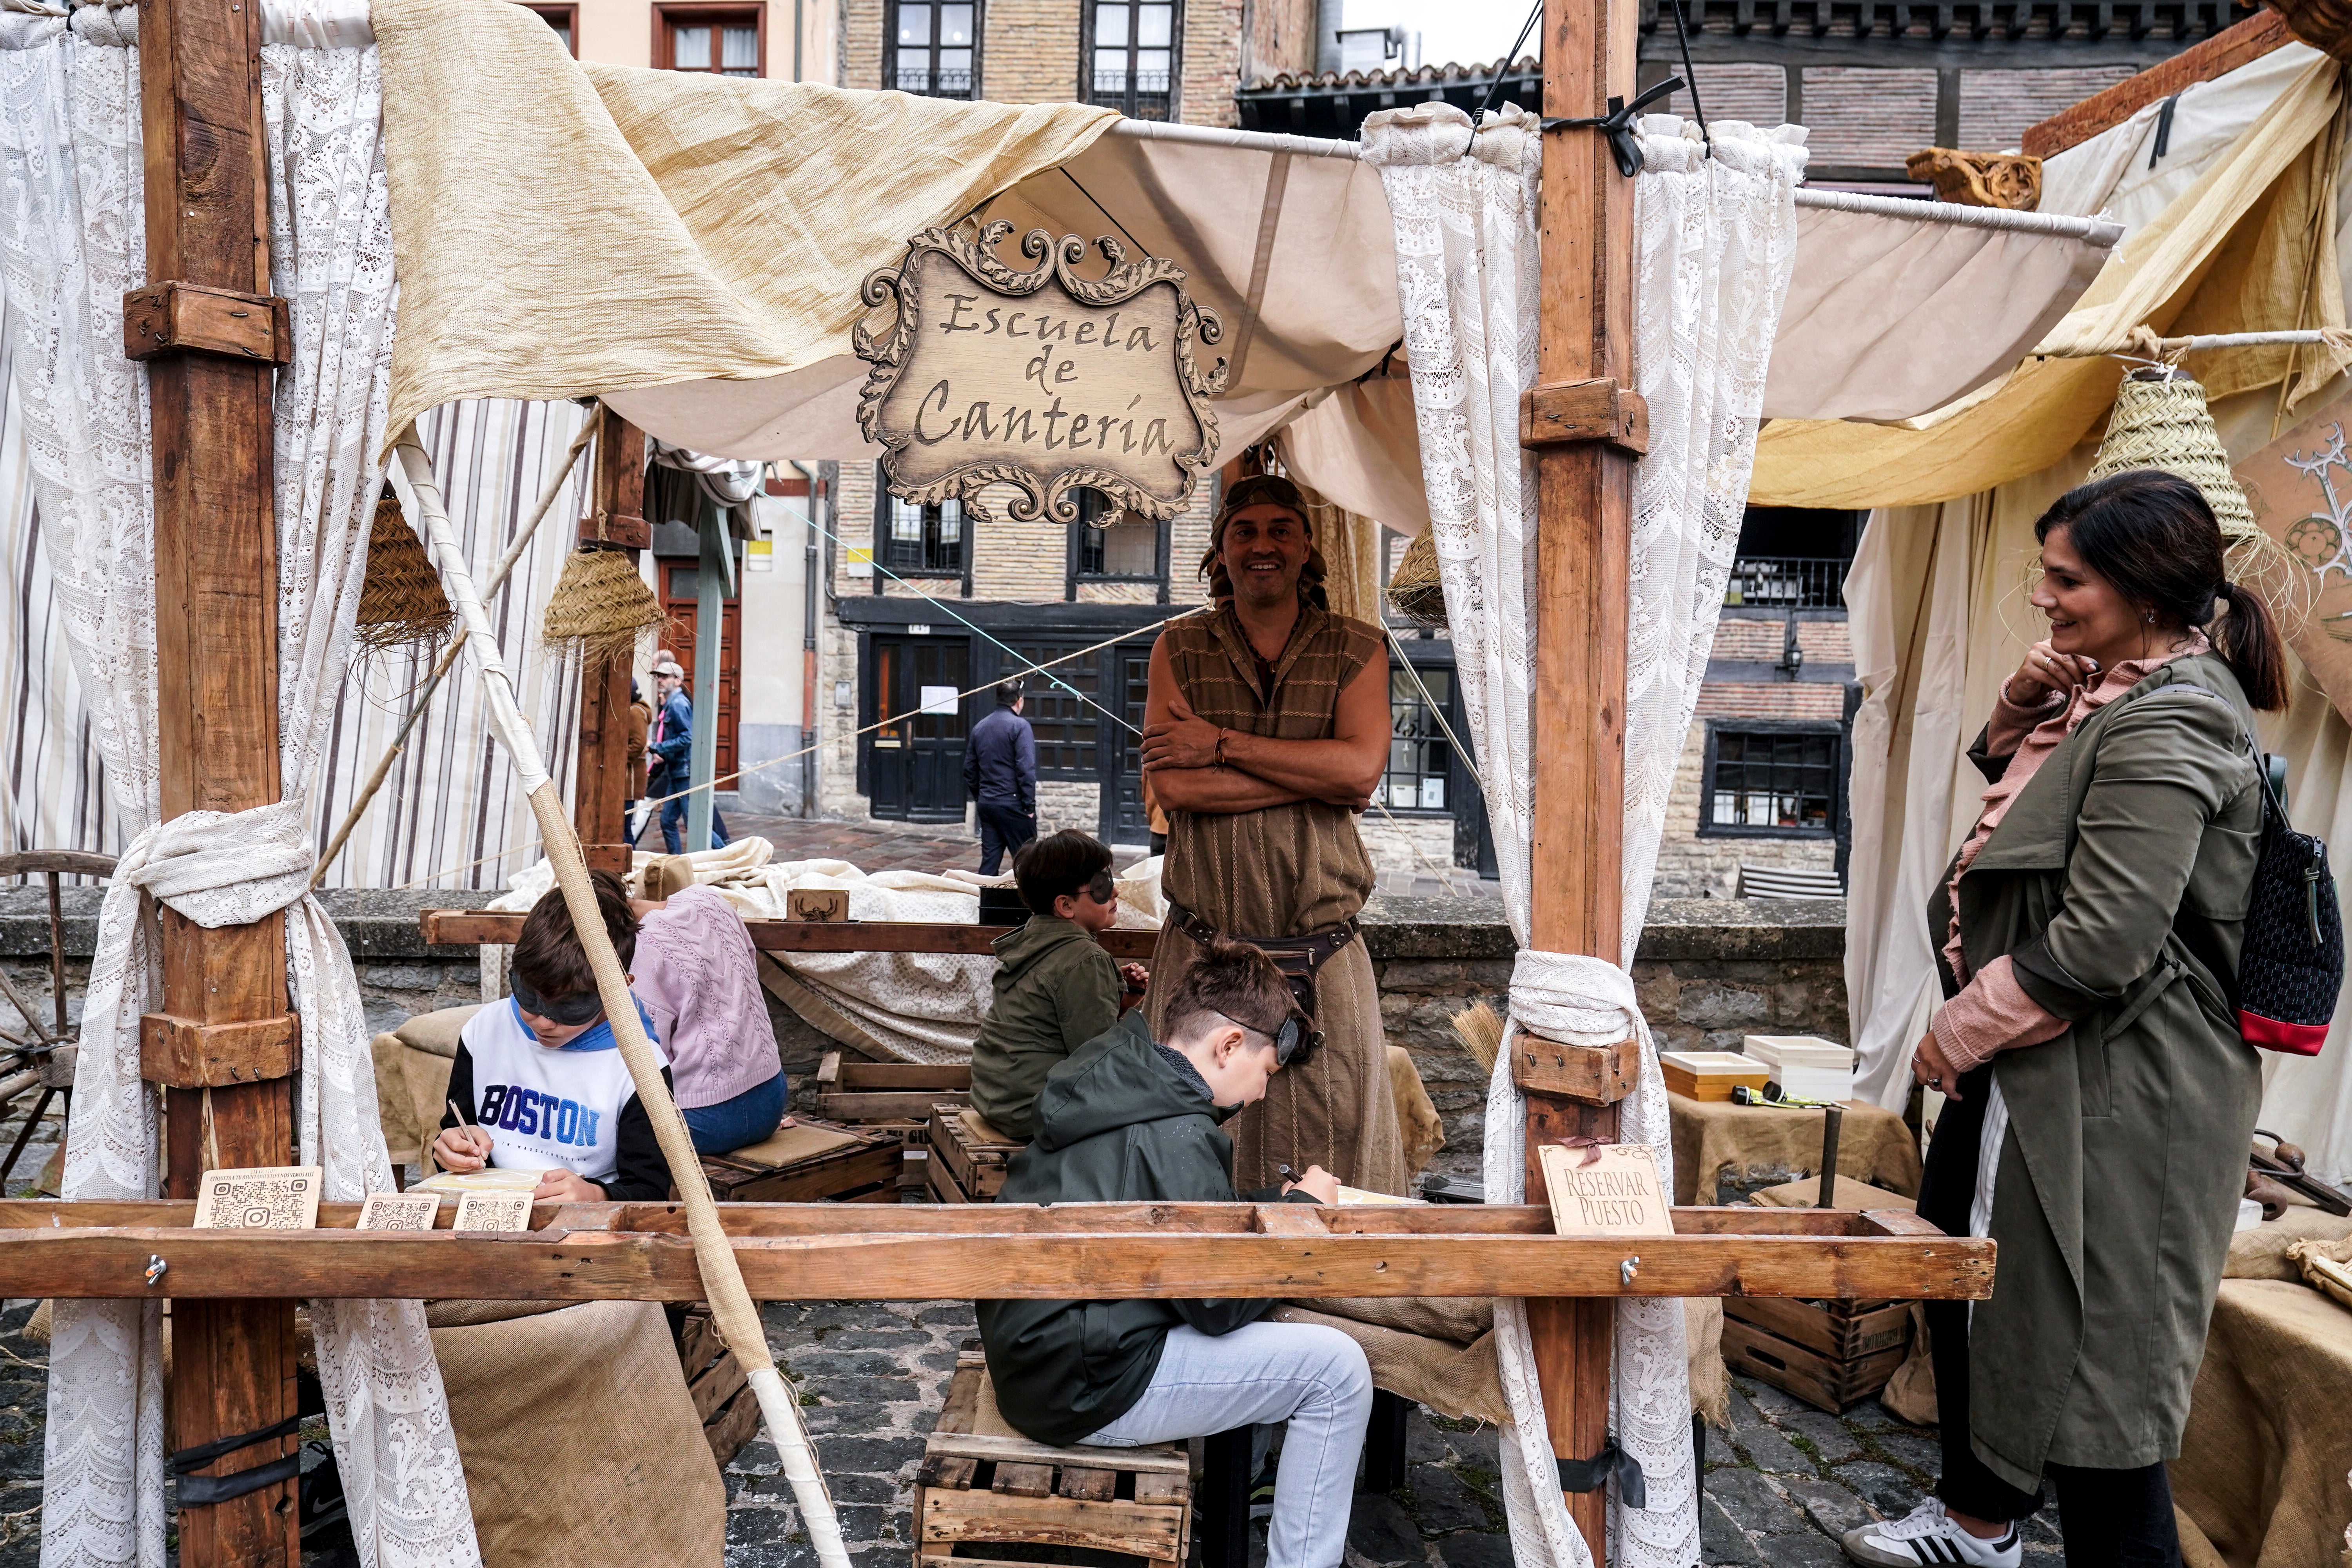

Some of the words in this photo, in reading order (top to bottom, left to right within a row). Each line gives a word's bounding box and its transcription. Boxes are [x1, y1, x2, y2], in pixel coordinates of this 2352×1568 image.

[939, 294, 1159, 351] Escuela
[1025, 345, 1078, 396] de
[914, 379, 1175, 456] Cantería
[477, 1085, 600, 1147] BOSTON
[517, 1145, 586, 1161] MASSACHUSETTS
[1563, 1169, 1650, 1196] RESERVAR
[1579, 1197, 1644, 1225] PUESTO
